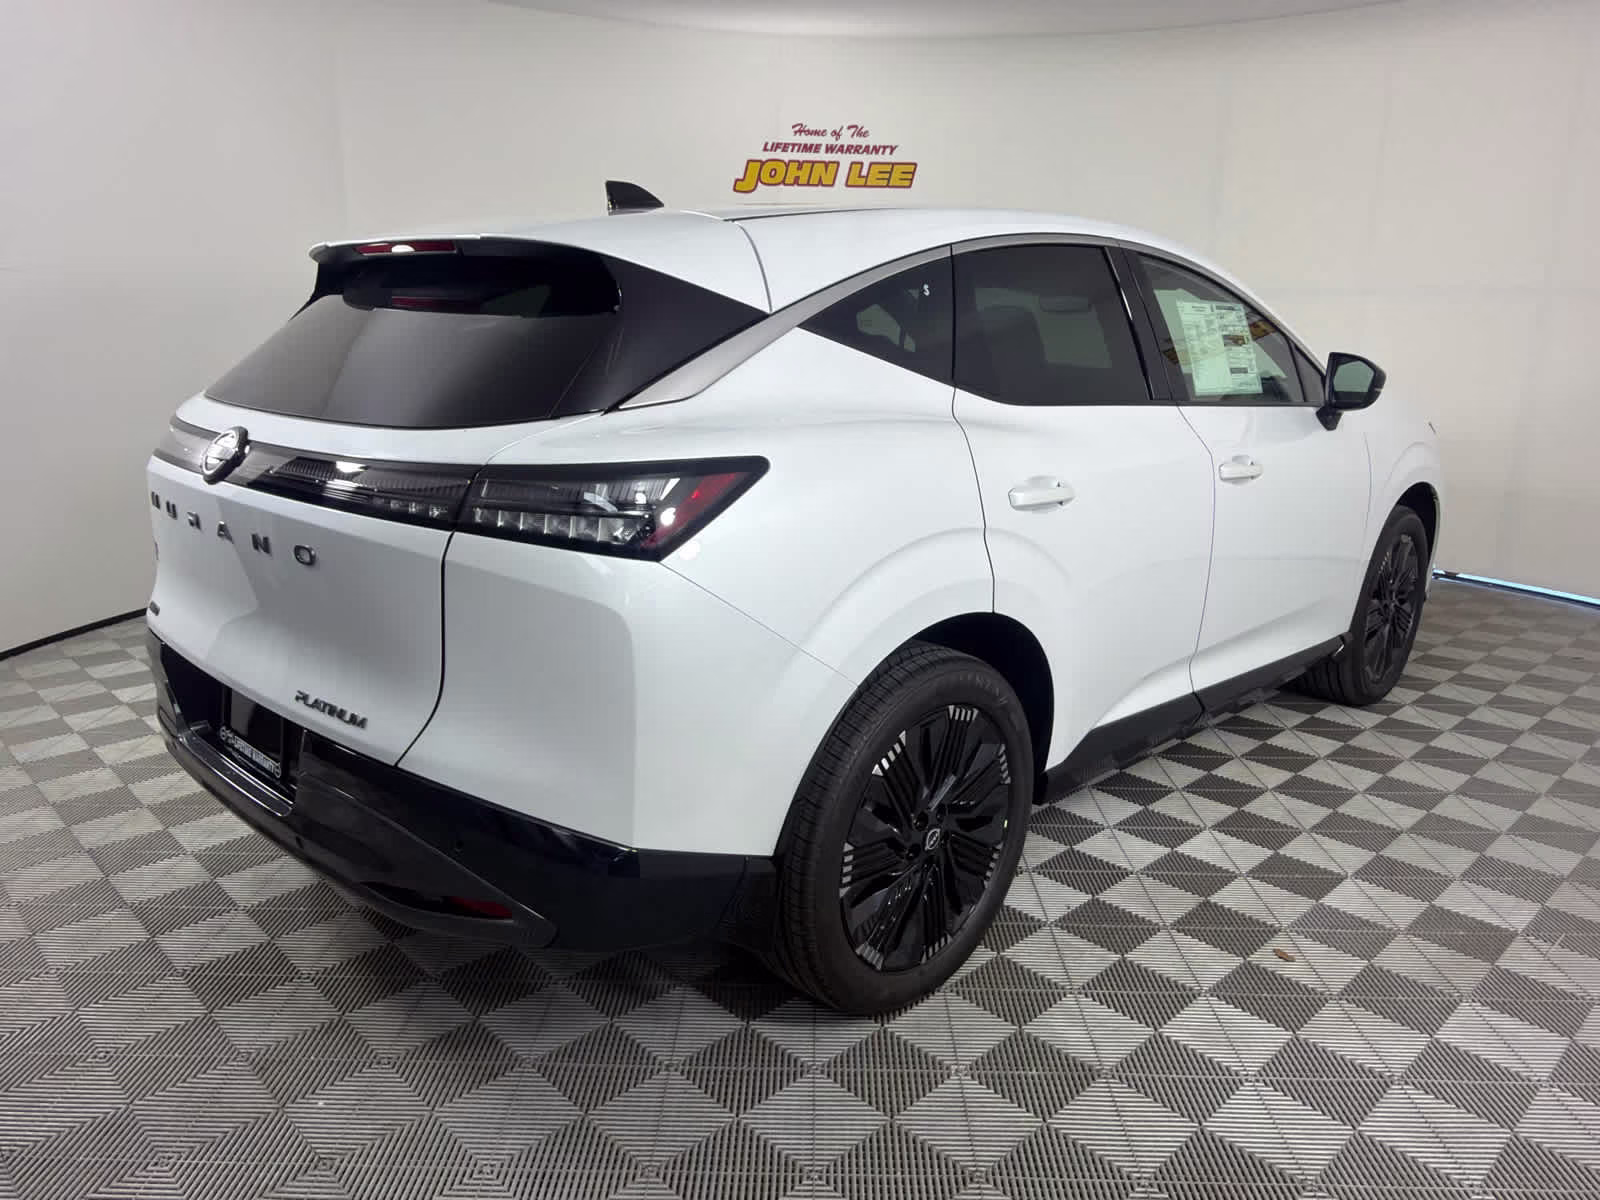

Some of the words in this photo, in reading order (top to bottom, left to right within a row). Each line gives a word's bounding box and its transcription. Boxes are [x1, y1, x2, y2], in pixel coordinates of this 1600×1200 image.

[791, 122, 827, 138] Home
[830, 125, 844, 141] of
[846, 124, 870, 138] The
[762, 141, 822, 154] LIFETIME
[824, 143, 898, 155] WARRANTY
[733, 158, 840, 194] JOHN
[845, 161, 918, 189] LEE
[295, 689, 369, 730] PLATINUM
